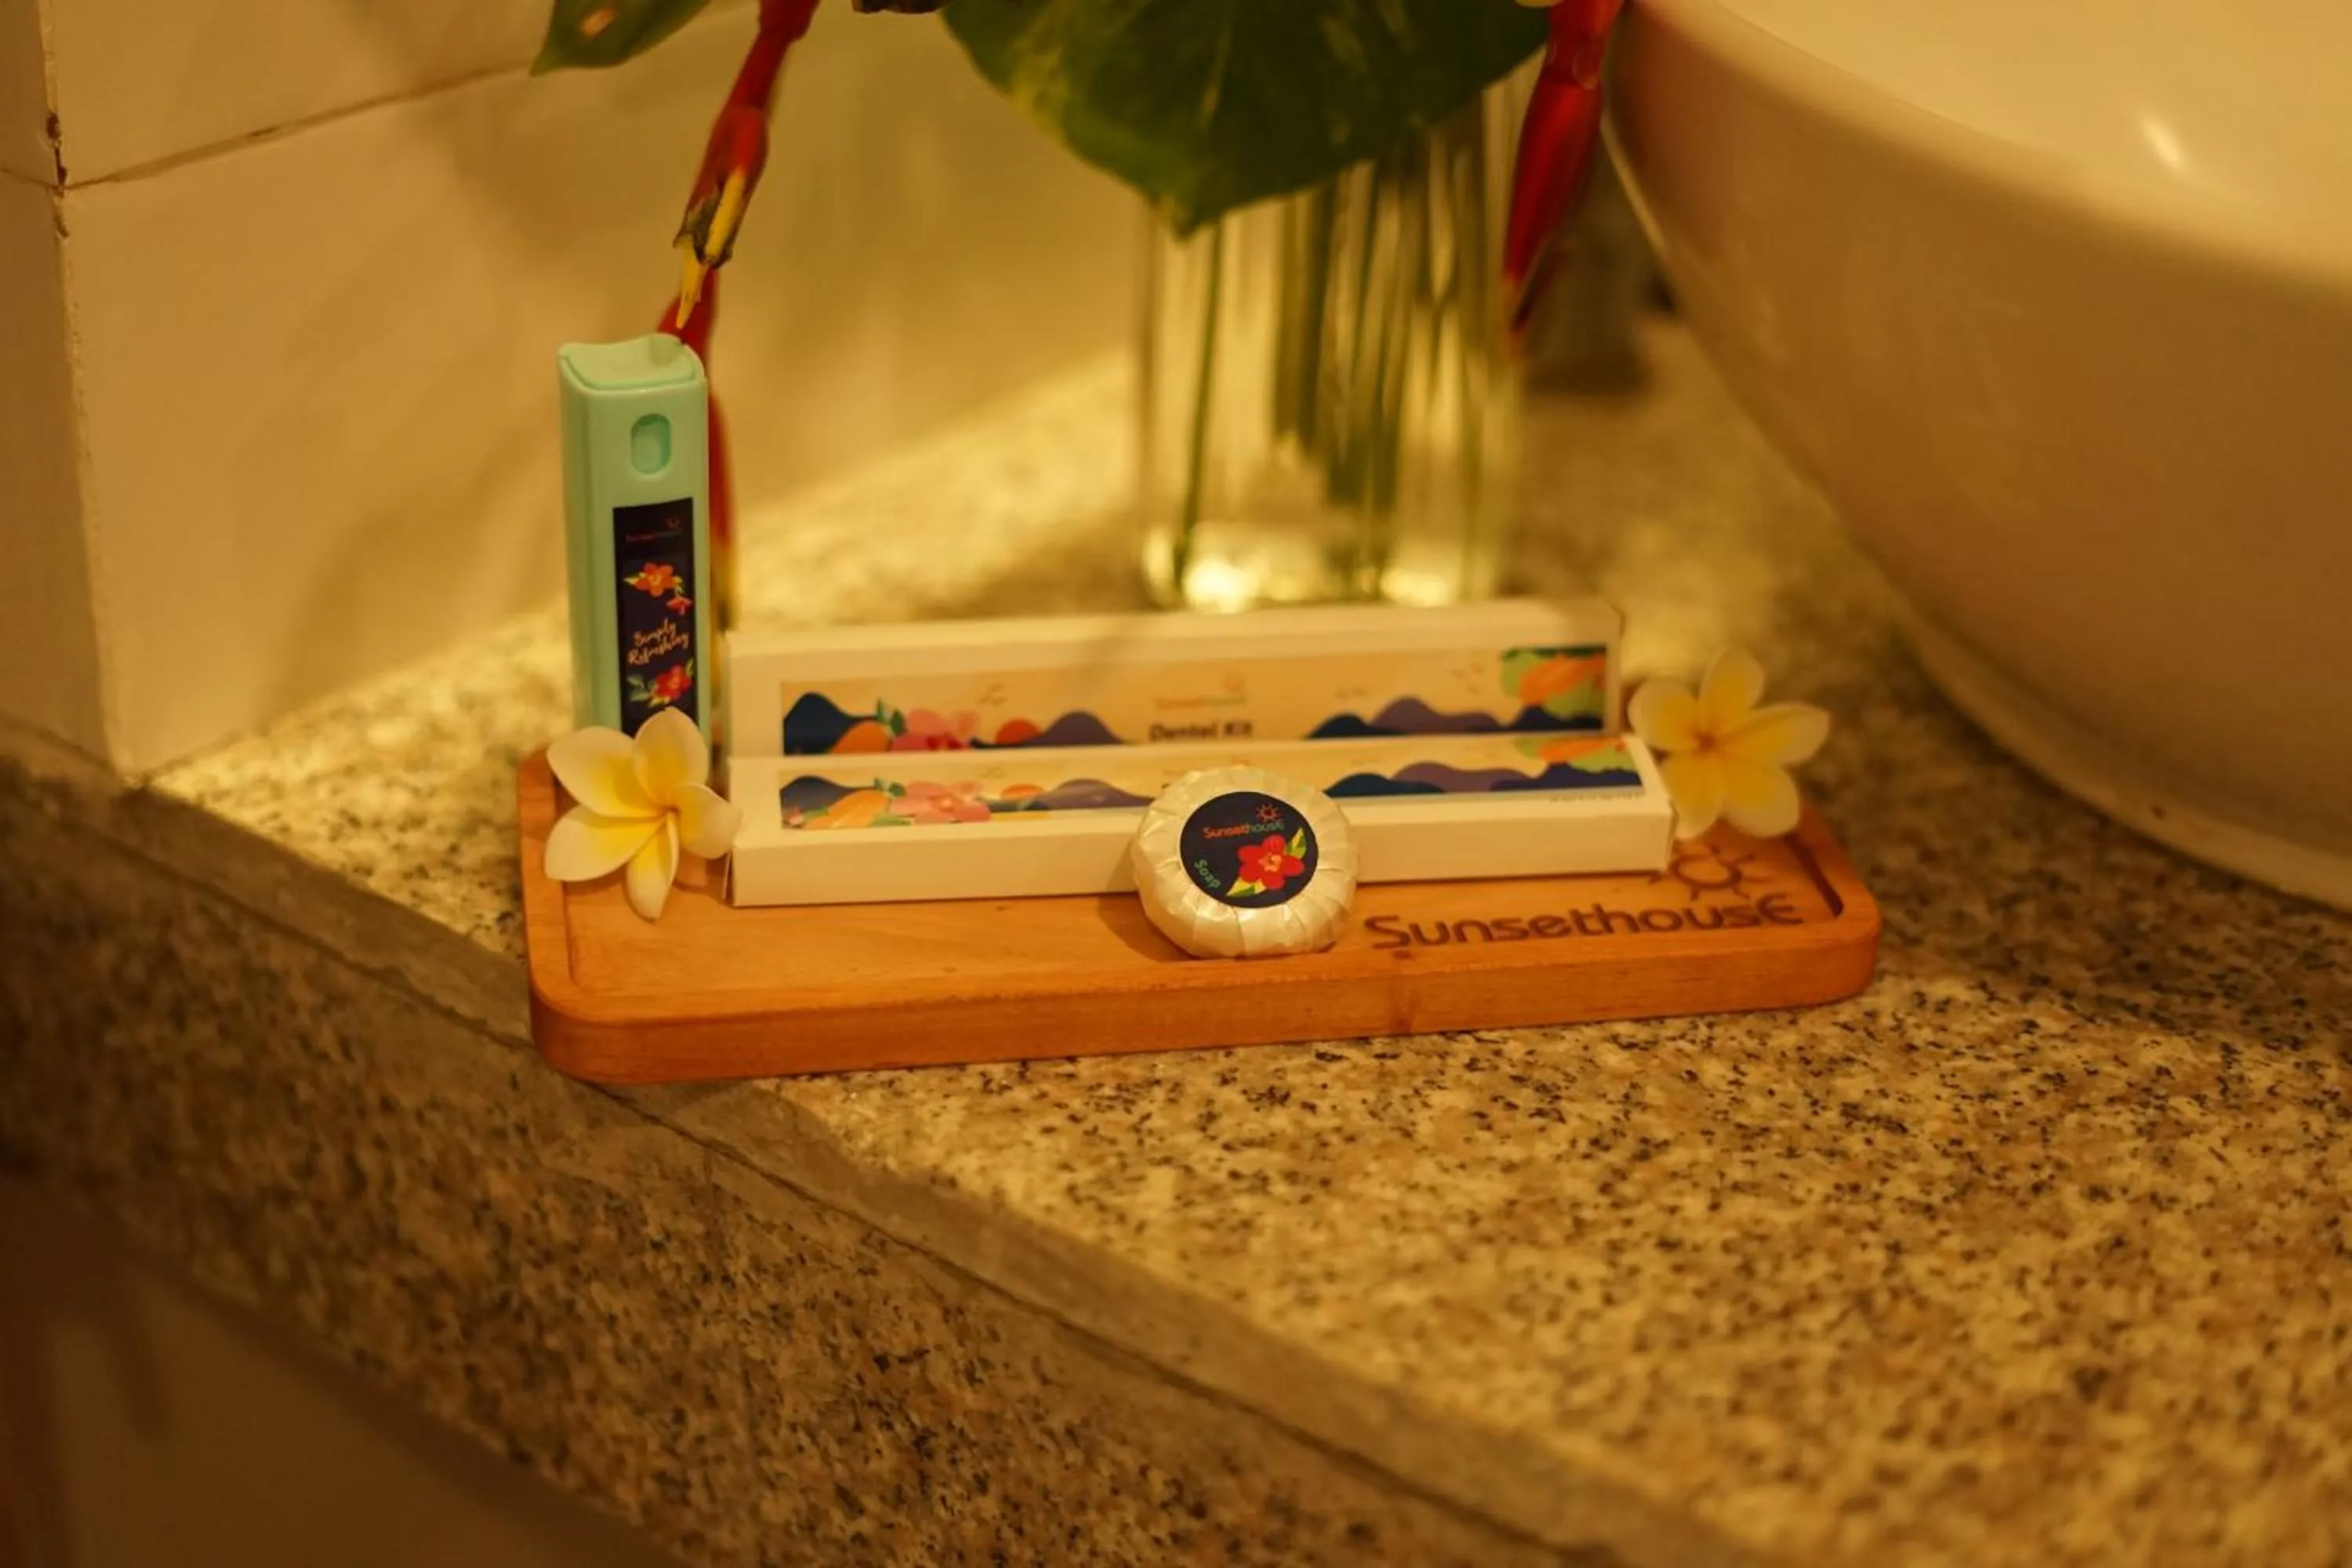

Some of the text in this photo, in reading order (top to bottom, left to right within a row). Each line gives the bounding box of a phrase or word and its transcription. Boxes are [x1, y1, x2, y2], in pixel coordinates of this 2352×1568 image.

[632, 618, 677, 648] Simply
[1149, 721, 1218, 742] Dental
[1193, 858, 1221, 888] Soap
